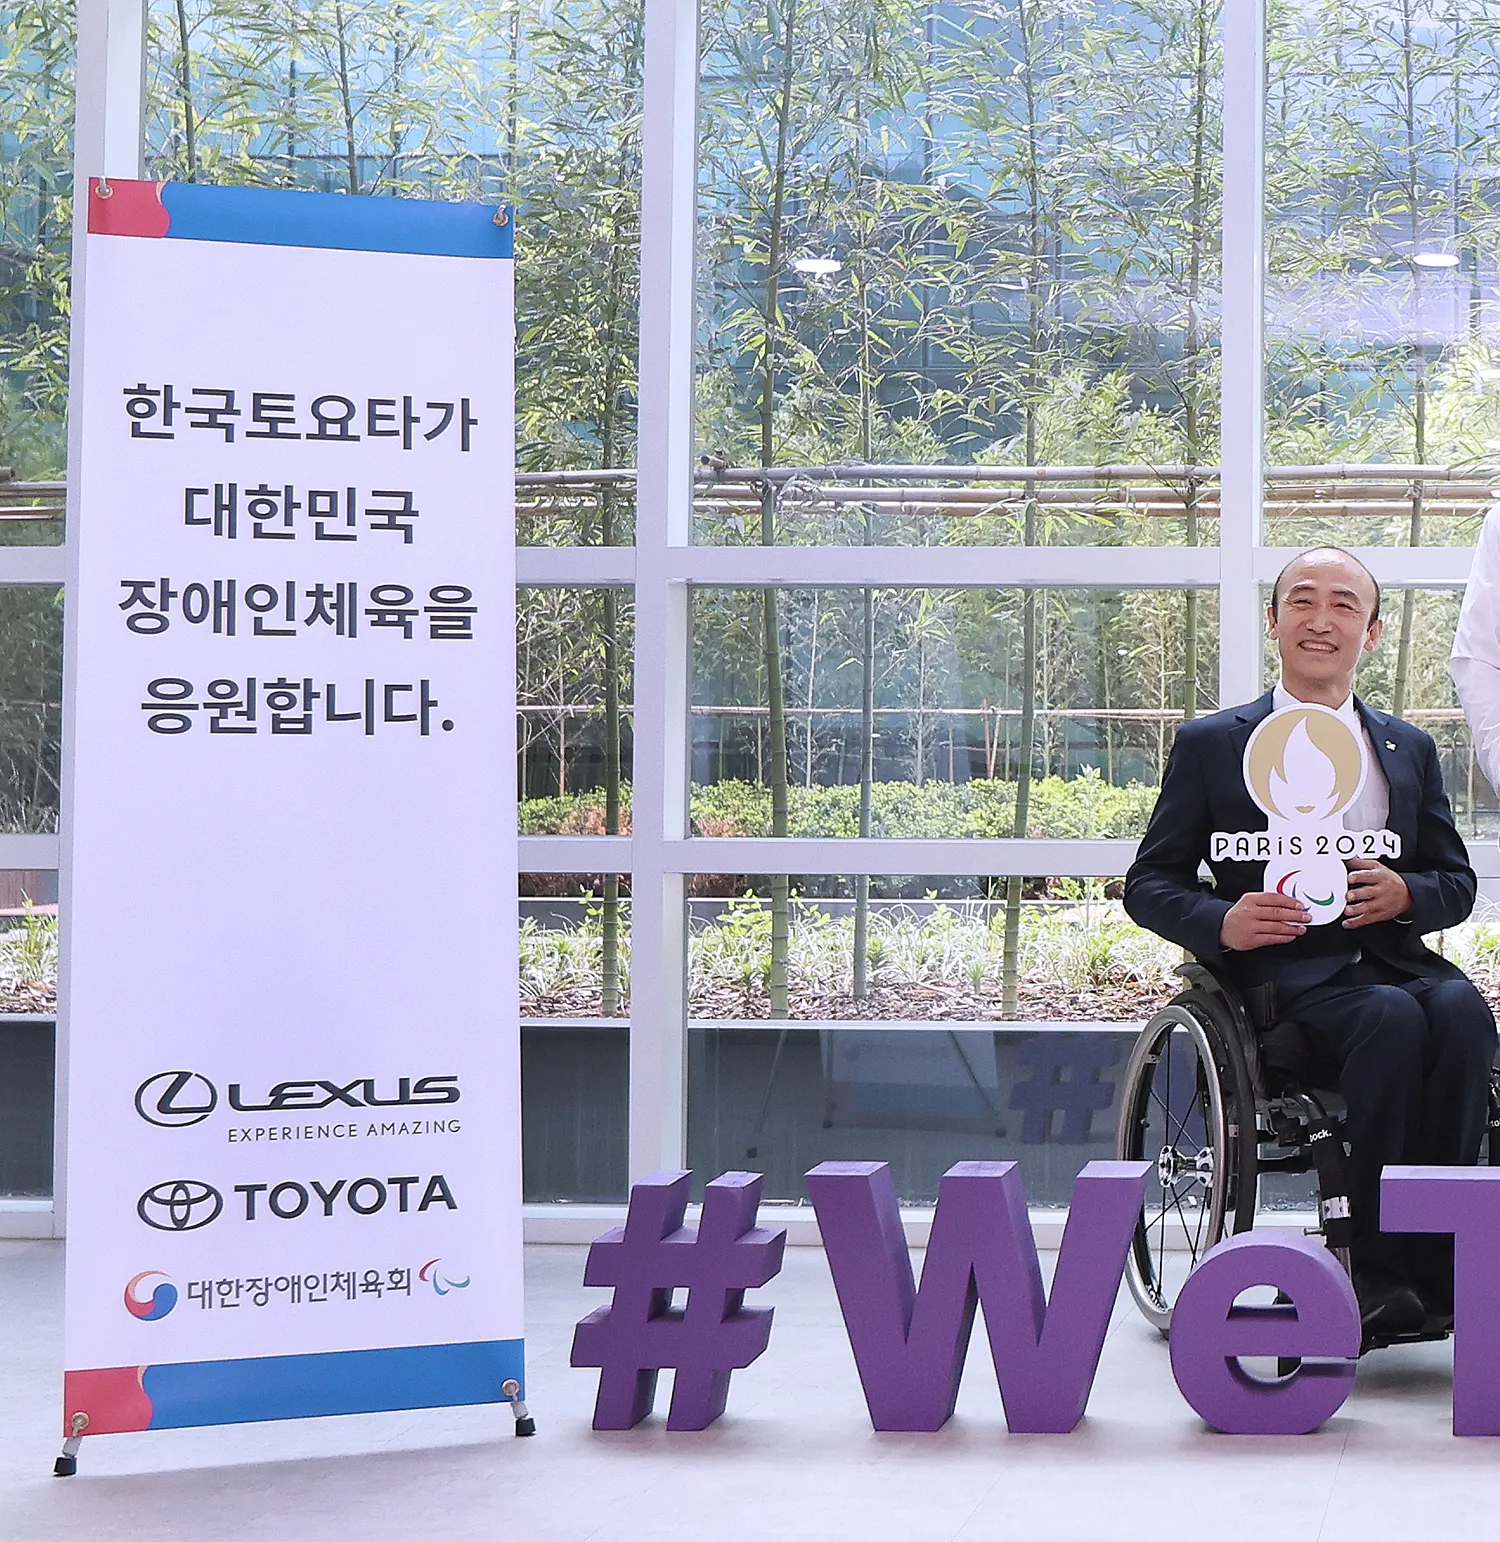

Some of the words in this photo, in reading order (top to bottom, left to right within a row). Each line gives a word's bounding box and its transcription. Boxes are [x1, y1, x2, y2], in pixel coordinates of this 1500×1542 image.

[122, 382, 479, 452] 한국토요타가
[184, 482, 420, 544] 대한민국
[118, 577, 479, 639] 장애인체육을
[140, 676, 455, 736] 응원합니다.
[1316, 834, 1395, 855] 2024
[228, 1075, 462, 1112] LEXUS
[228, 1123, 358, 1144] EXPERIENCE
[366, 1118, 462, 1138] AMAZING
[233, 1174, 458, 1221] TOYOTA
[187, 1267, 412, 1310] 대한장애인체육회
